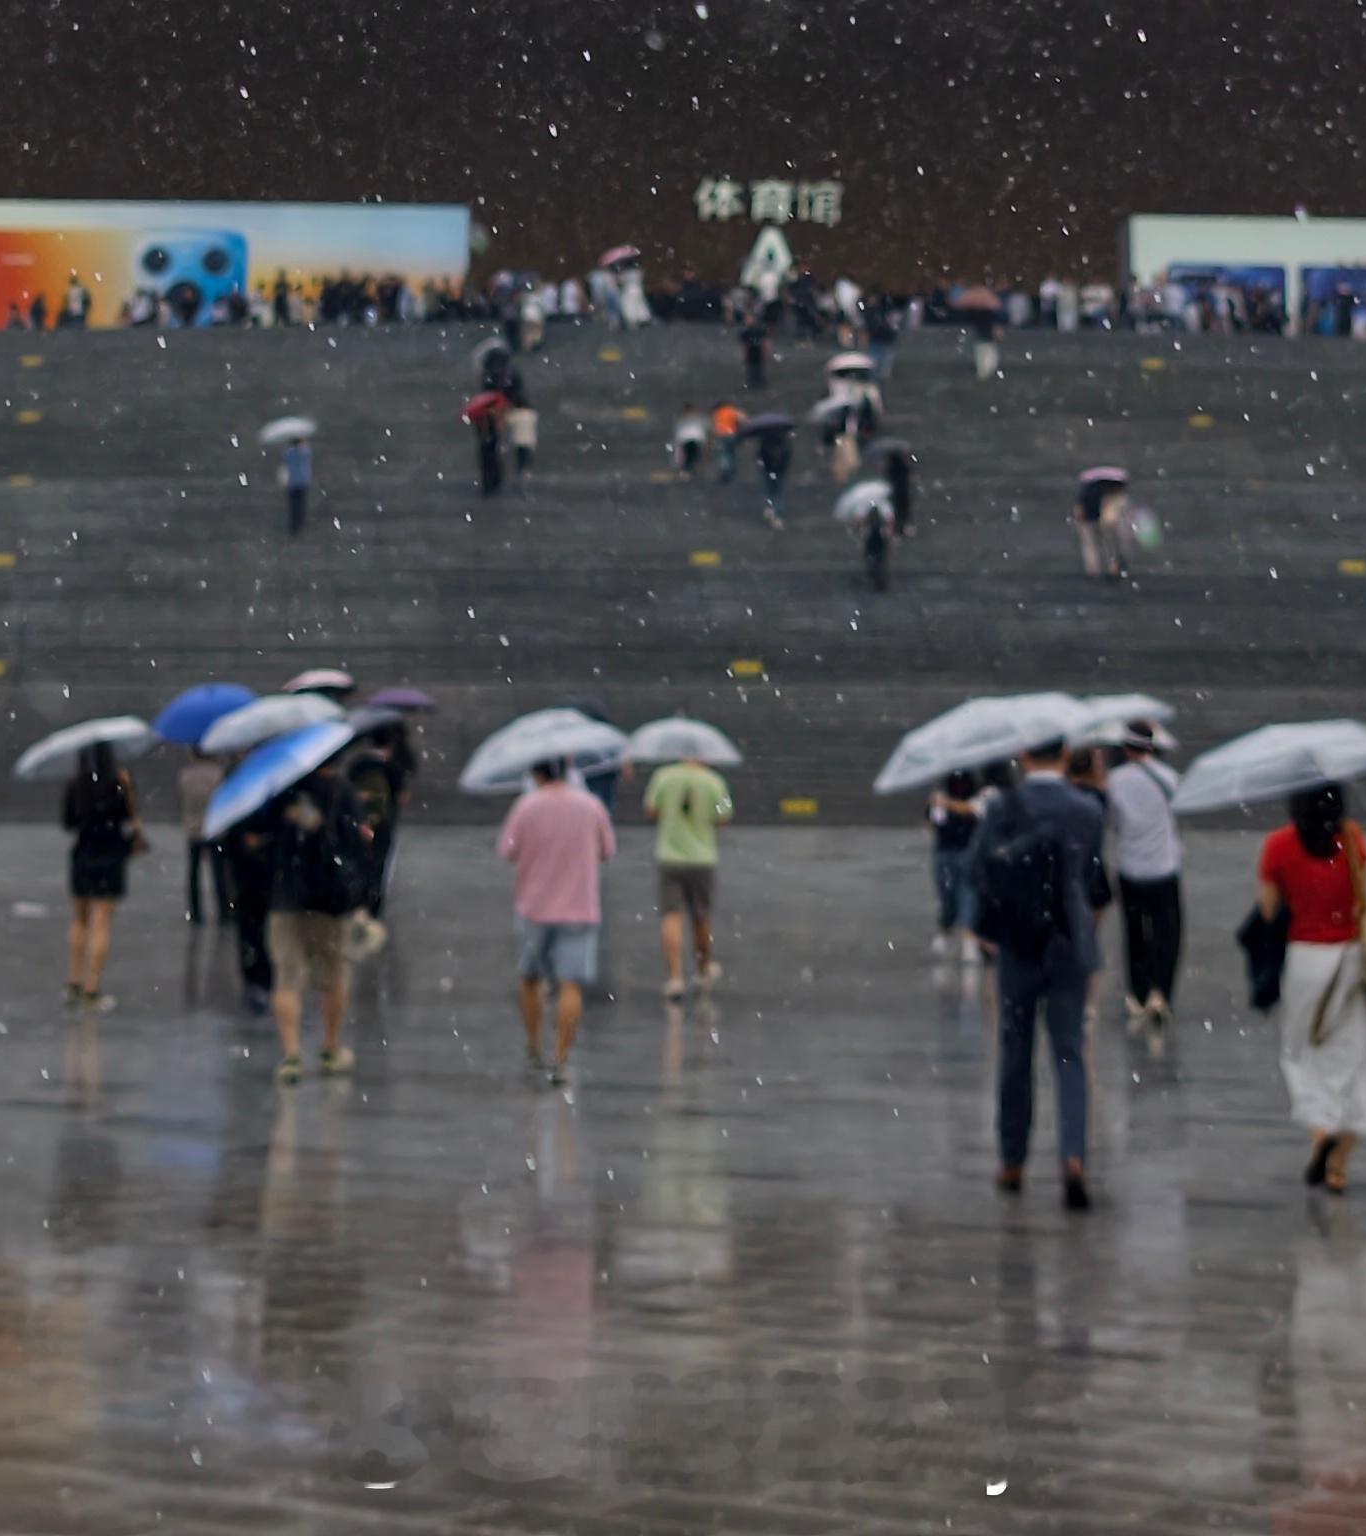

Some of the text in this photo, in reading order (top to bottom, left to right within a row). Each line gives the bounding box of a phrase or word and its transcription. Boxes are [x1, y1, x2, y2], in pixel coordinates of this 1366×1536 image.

[695, 178, 844, 226] 体育馆
[741, 226, 795, 287] A
